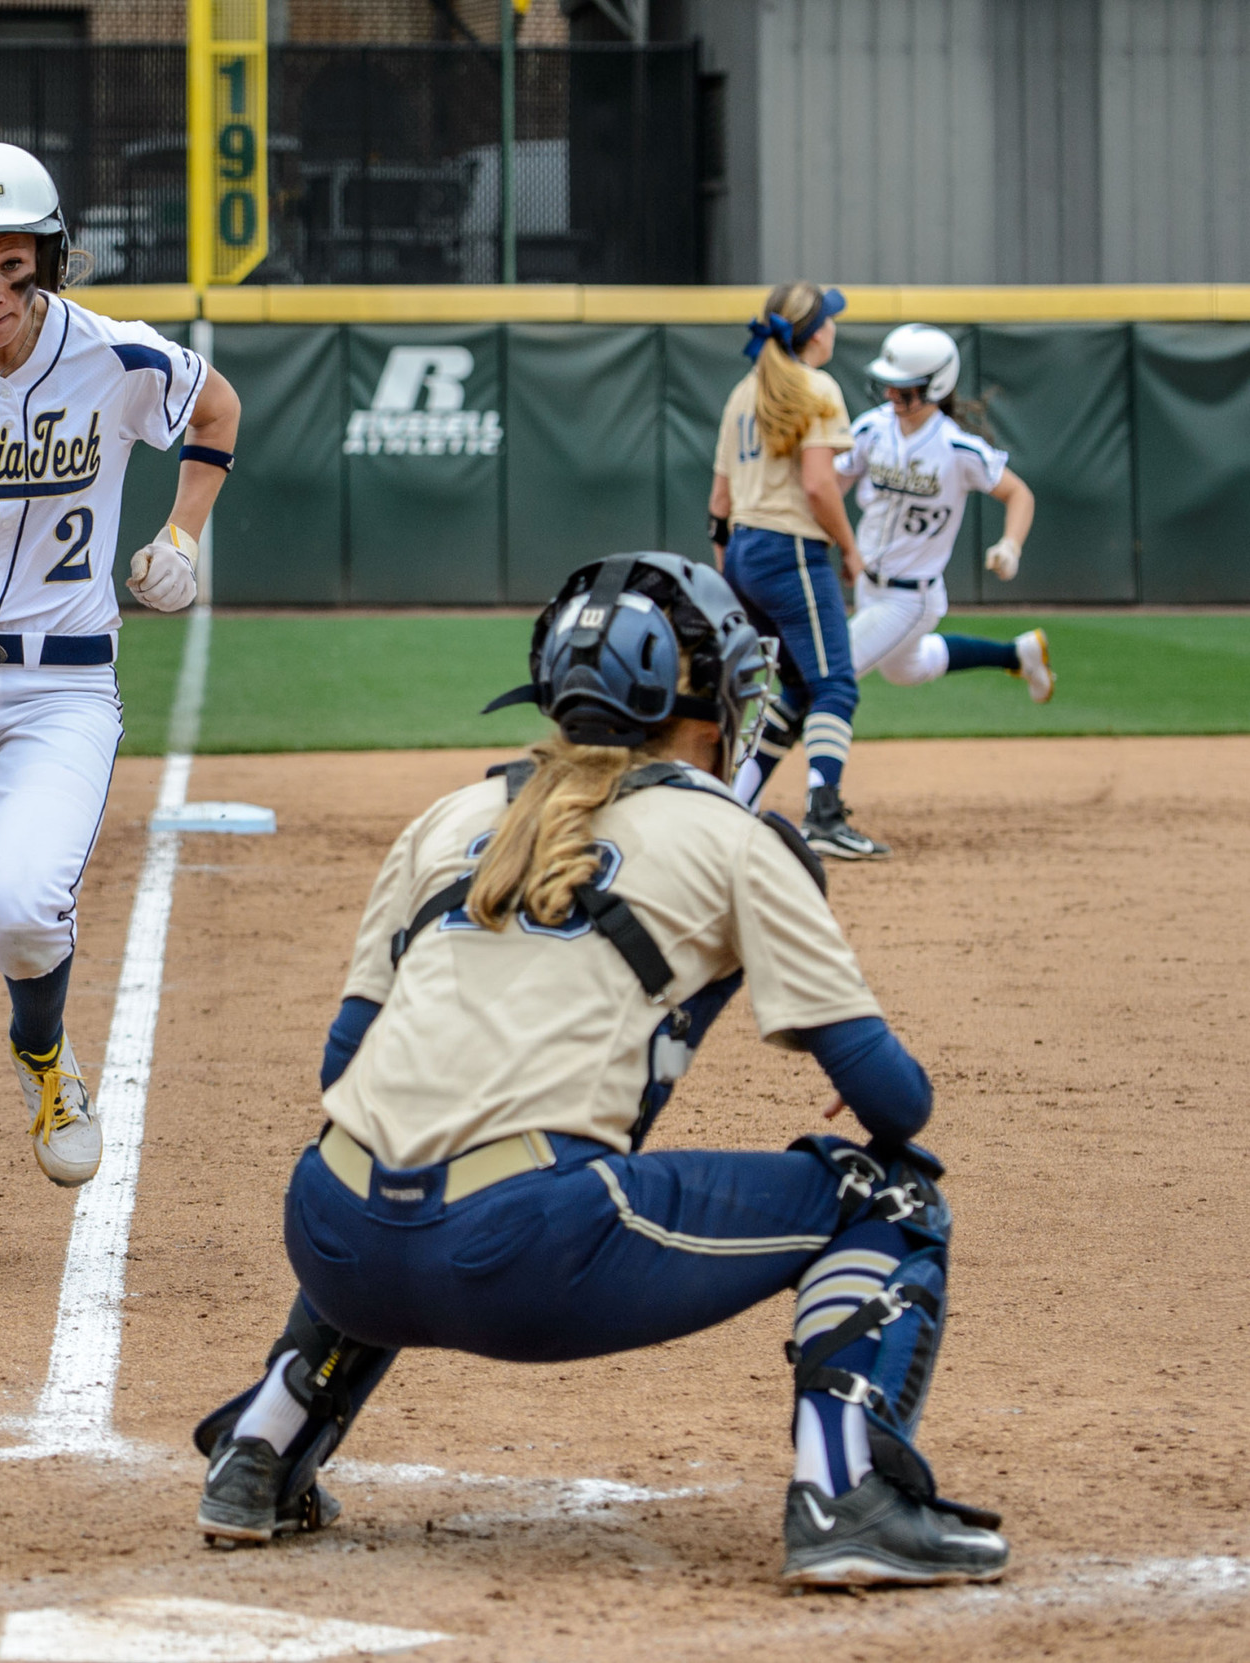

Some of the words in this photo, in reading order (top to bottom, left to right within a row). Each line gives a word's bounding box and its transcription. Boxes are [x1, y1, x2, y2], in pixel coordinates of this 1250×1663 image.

[218, 56, 257, 247] 190
[27, 407, 101, 481] Tech
[43, 505, 95, 586] 2
